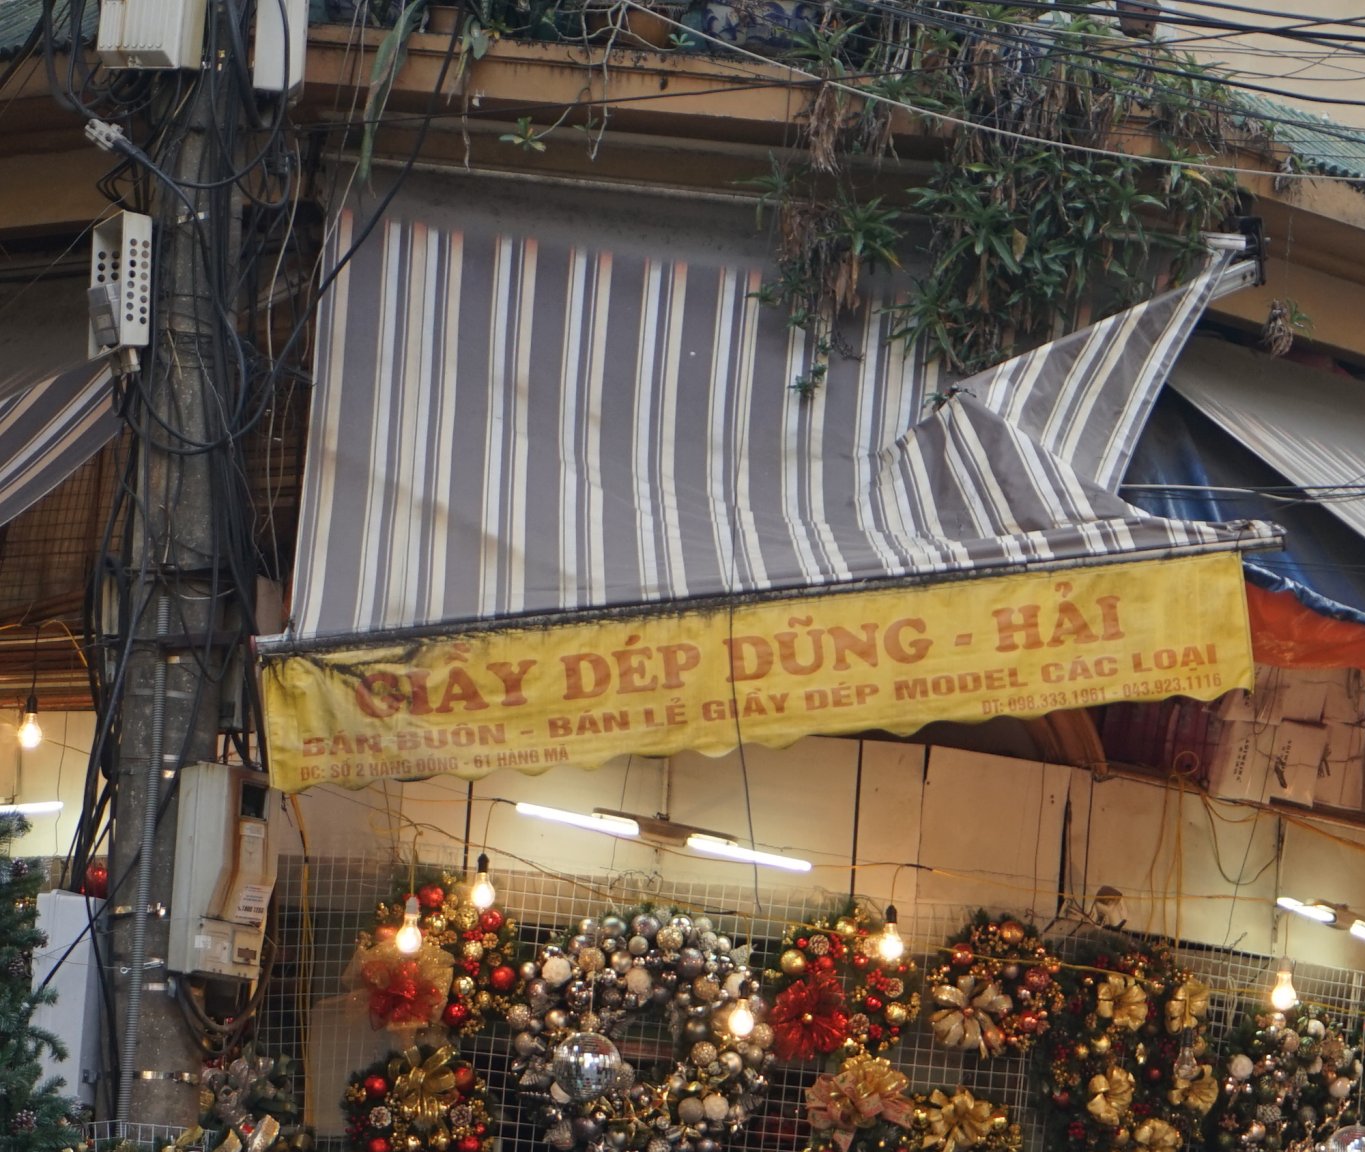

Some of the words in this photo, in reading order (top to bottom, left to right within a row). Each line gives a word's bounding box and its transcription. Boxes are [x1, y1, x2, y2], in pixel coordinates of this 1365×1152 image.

[560, 635, 702, 702] DÉP
[723, 615, 934, 683] DŨNG
[993, 581, 1126, 653] HẢI
[302, 728, 382, 757] BÁN
[398, 720, 507, 752] BUÔN
[549, 706, 631, 739] BÁN
[644, 696, 689, 727] LẺ
[804, 682, 880, 714] DÉP
[899, 669, 1029, 701] MODEL
[1041, 652, 1120, 685] CÁC
[1133, 643, 1219, 676] LOẠI
[1121, 672, 1223, 699] 043.923.1116
[355, 762, 367, 776] 2
[369, 756, 412, 778] HÀNG
[474, 755, 492, 770] 61
[498, 747, 540, 768] HÀNG
[543, 743, 570, 764] MÃ
